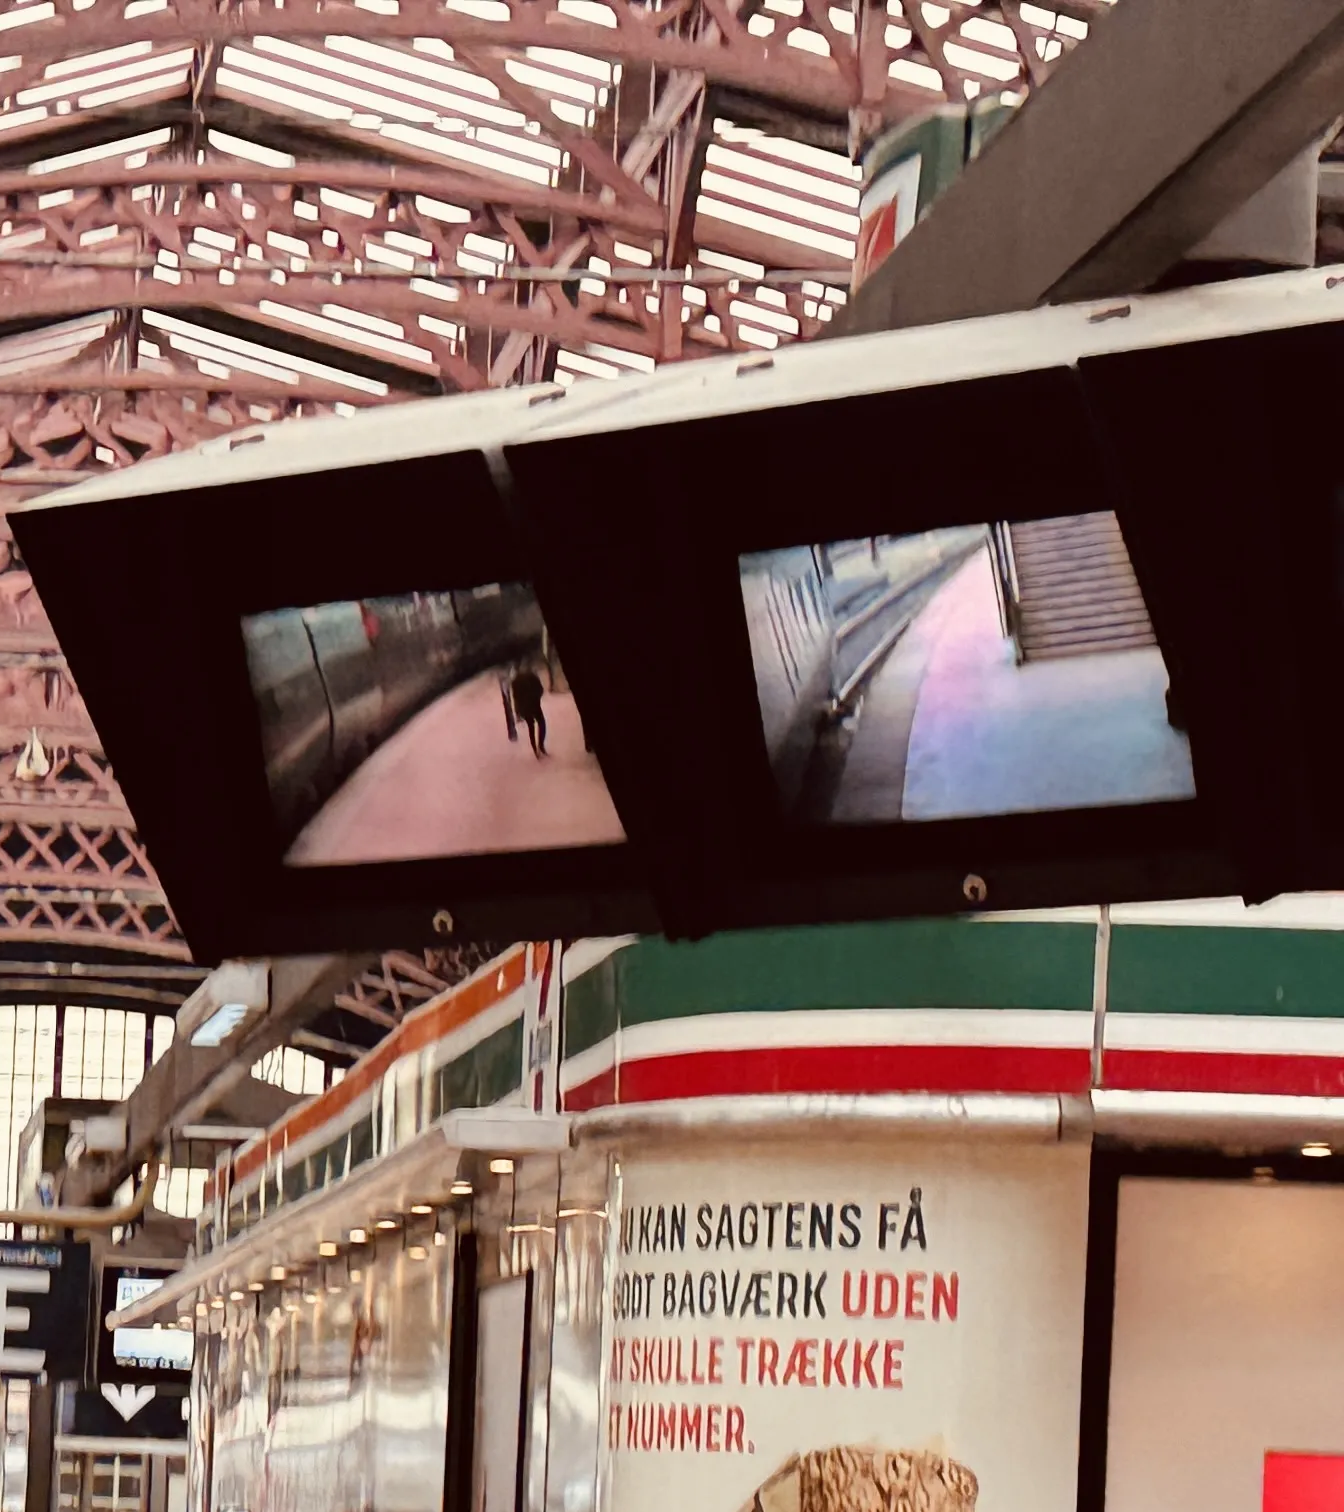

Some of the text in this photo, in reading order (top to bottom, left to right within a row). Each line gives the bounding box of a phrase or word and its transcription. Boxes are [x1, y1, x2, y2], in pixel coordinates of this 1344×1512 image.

[619, 1185, 927, 1254] U KAN SAGTENS FÅ
[662, 1269, 828, 1320] BAGVÆRK
[842, 1270, 960, 1322] UDEN
[630, 1336, 724, 1386] SKULLE
[736, 1336, 905, 1390] TRÆKKE
[627, 1401, 756, 1455] NUMMER.
